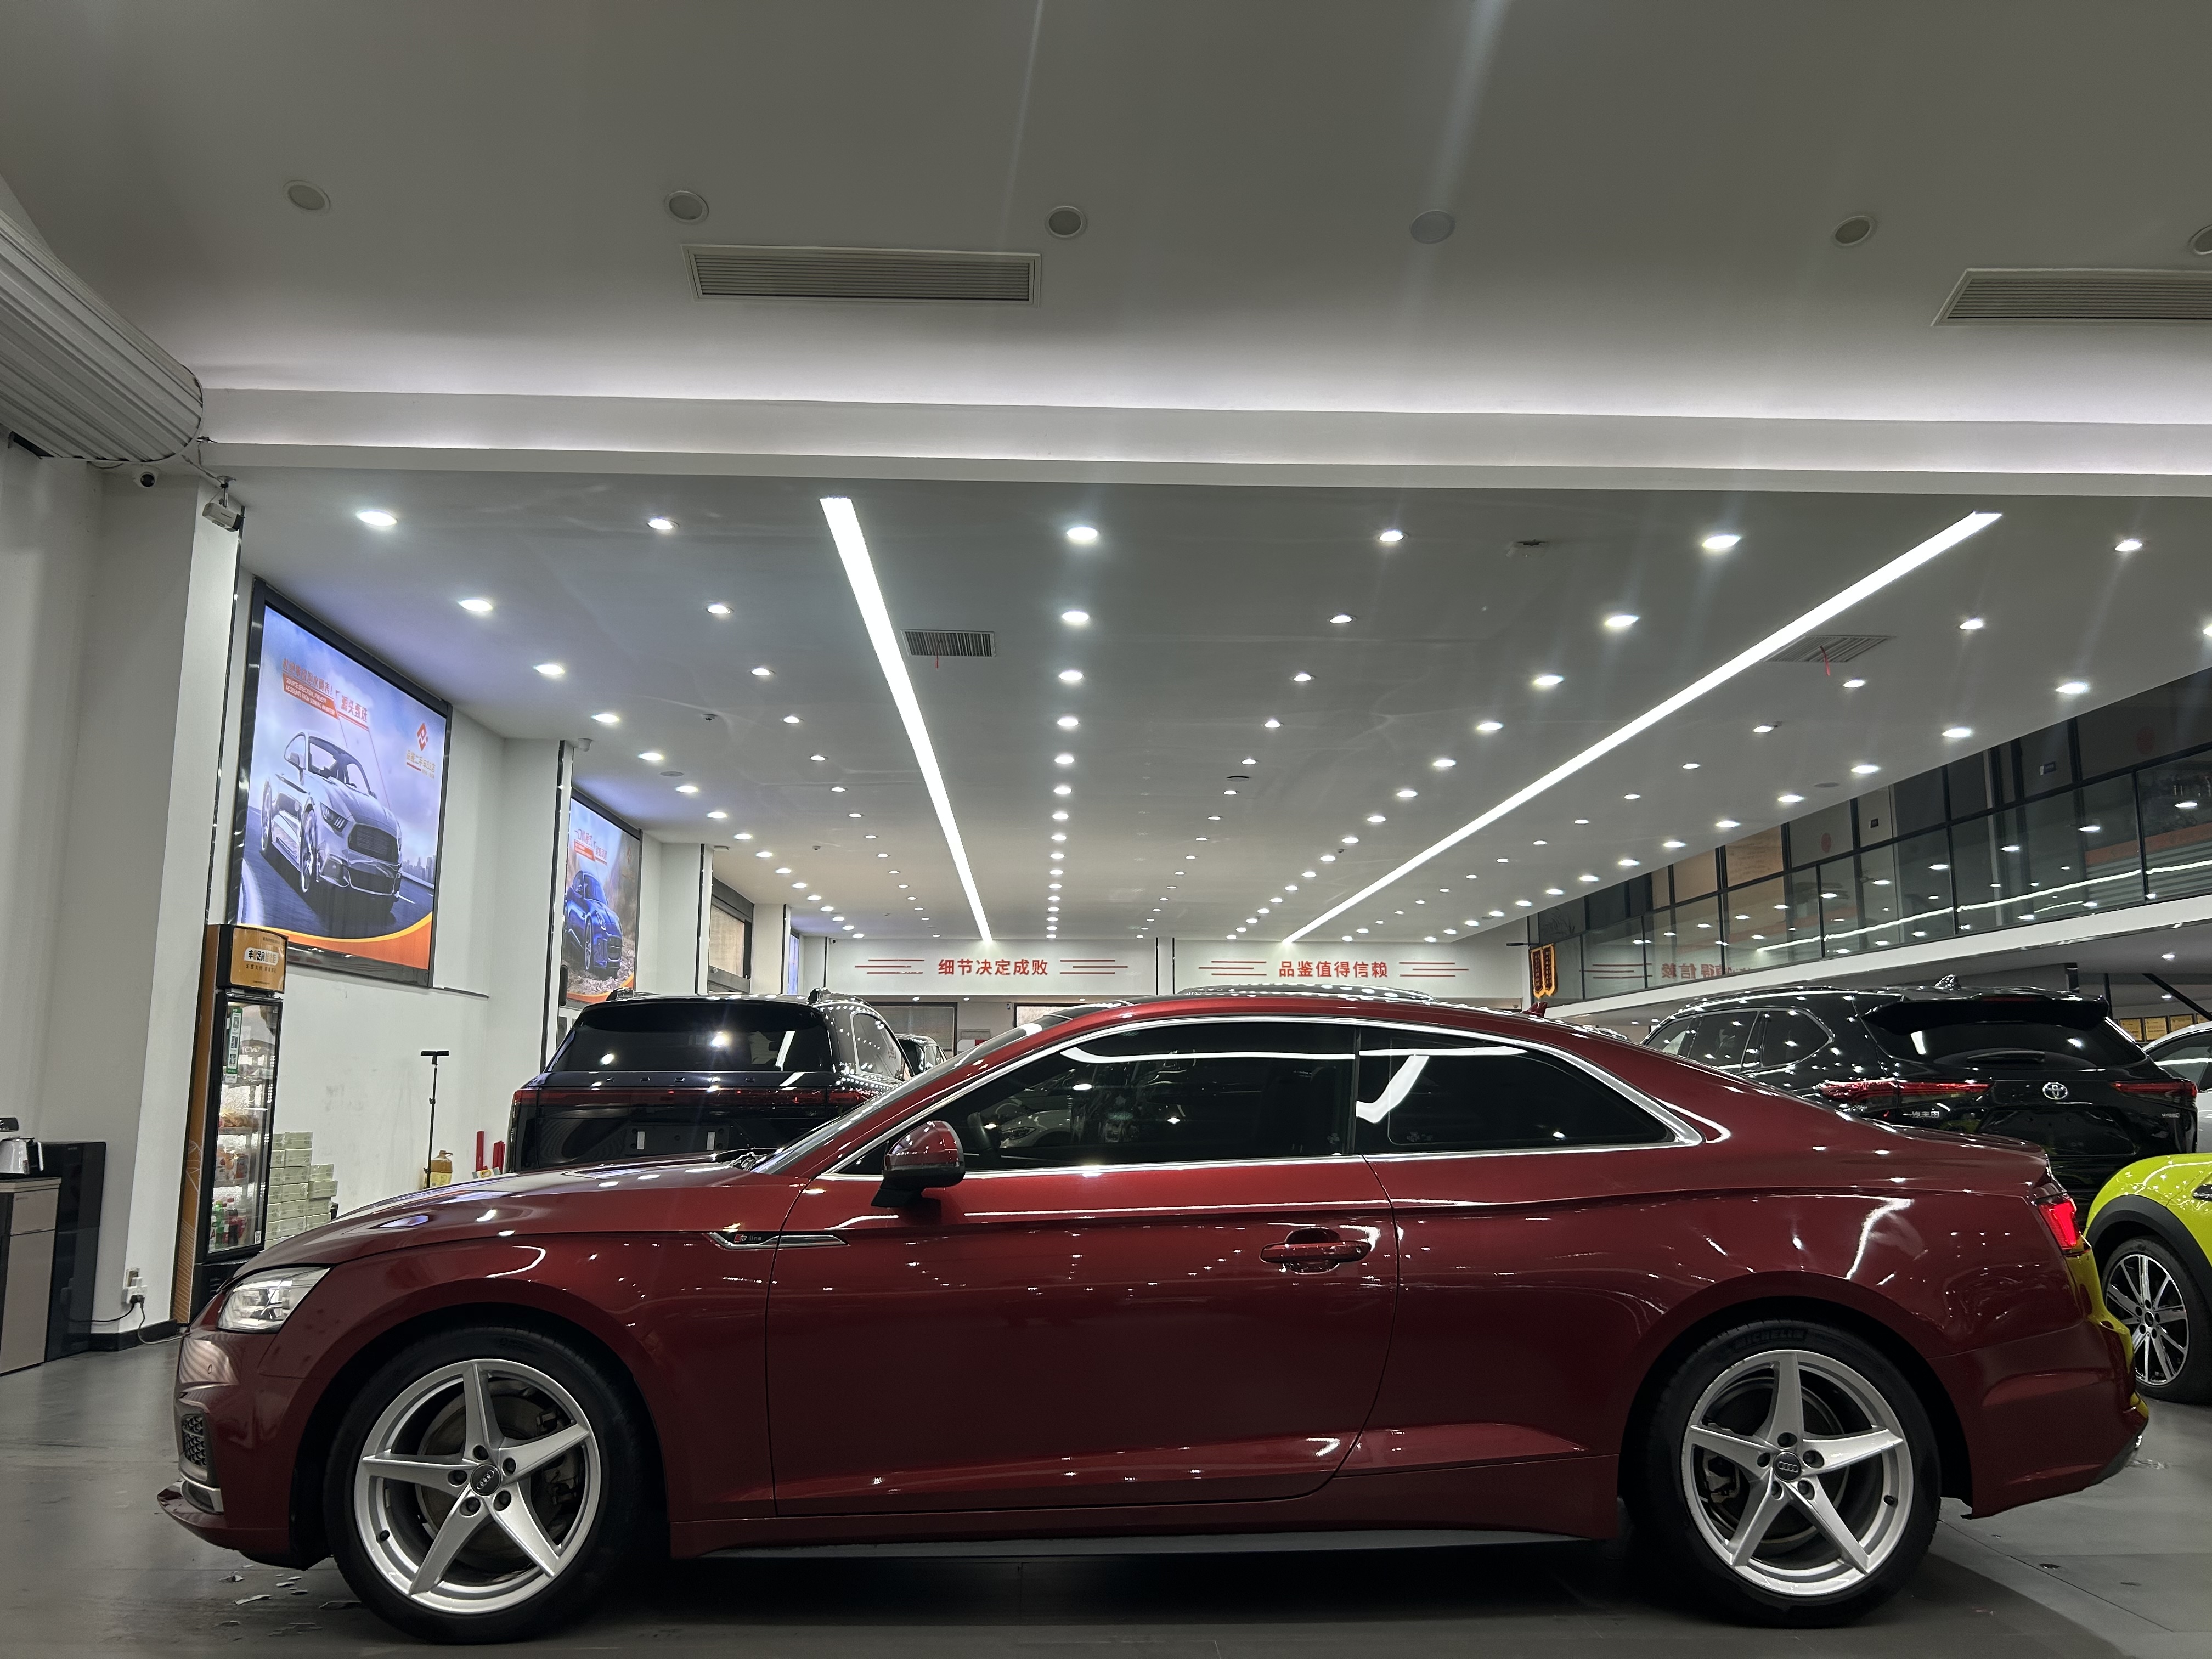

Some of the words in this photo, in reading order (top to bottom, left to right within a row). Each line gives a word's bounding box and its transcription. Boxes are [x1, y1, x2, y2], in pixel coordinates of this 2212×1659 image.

[938, 959, 1048, 975] 细节决定成败
[1279, 961, 1388, 978] 品鉴值得信赖
[1734, 1328, 1807, 1350] MICHELIN
